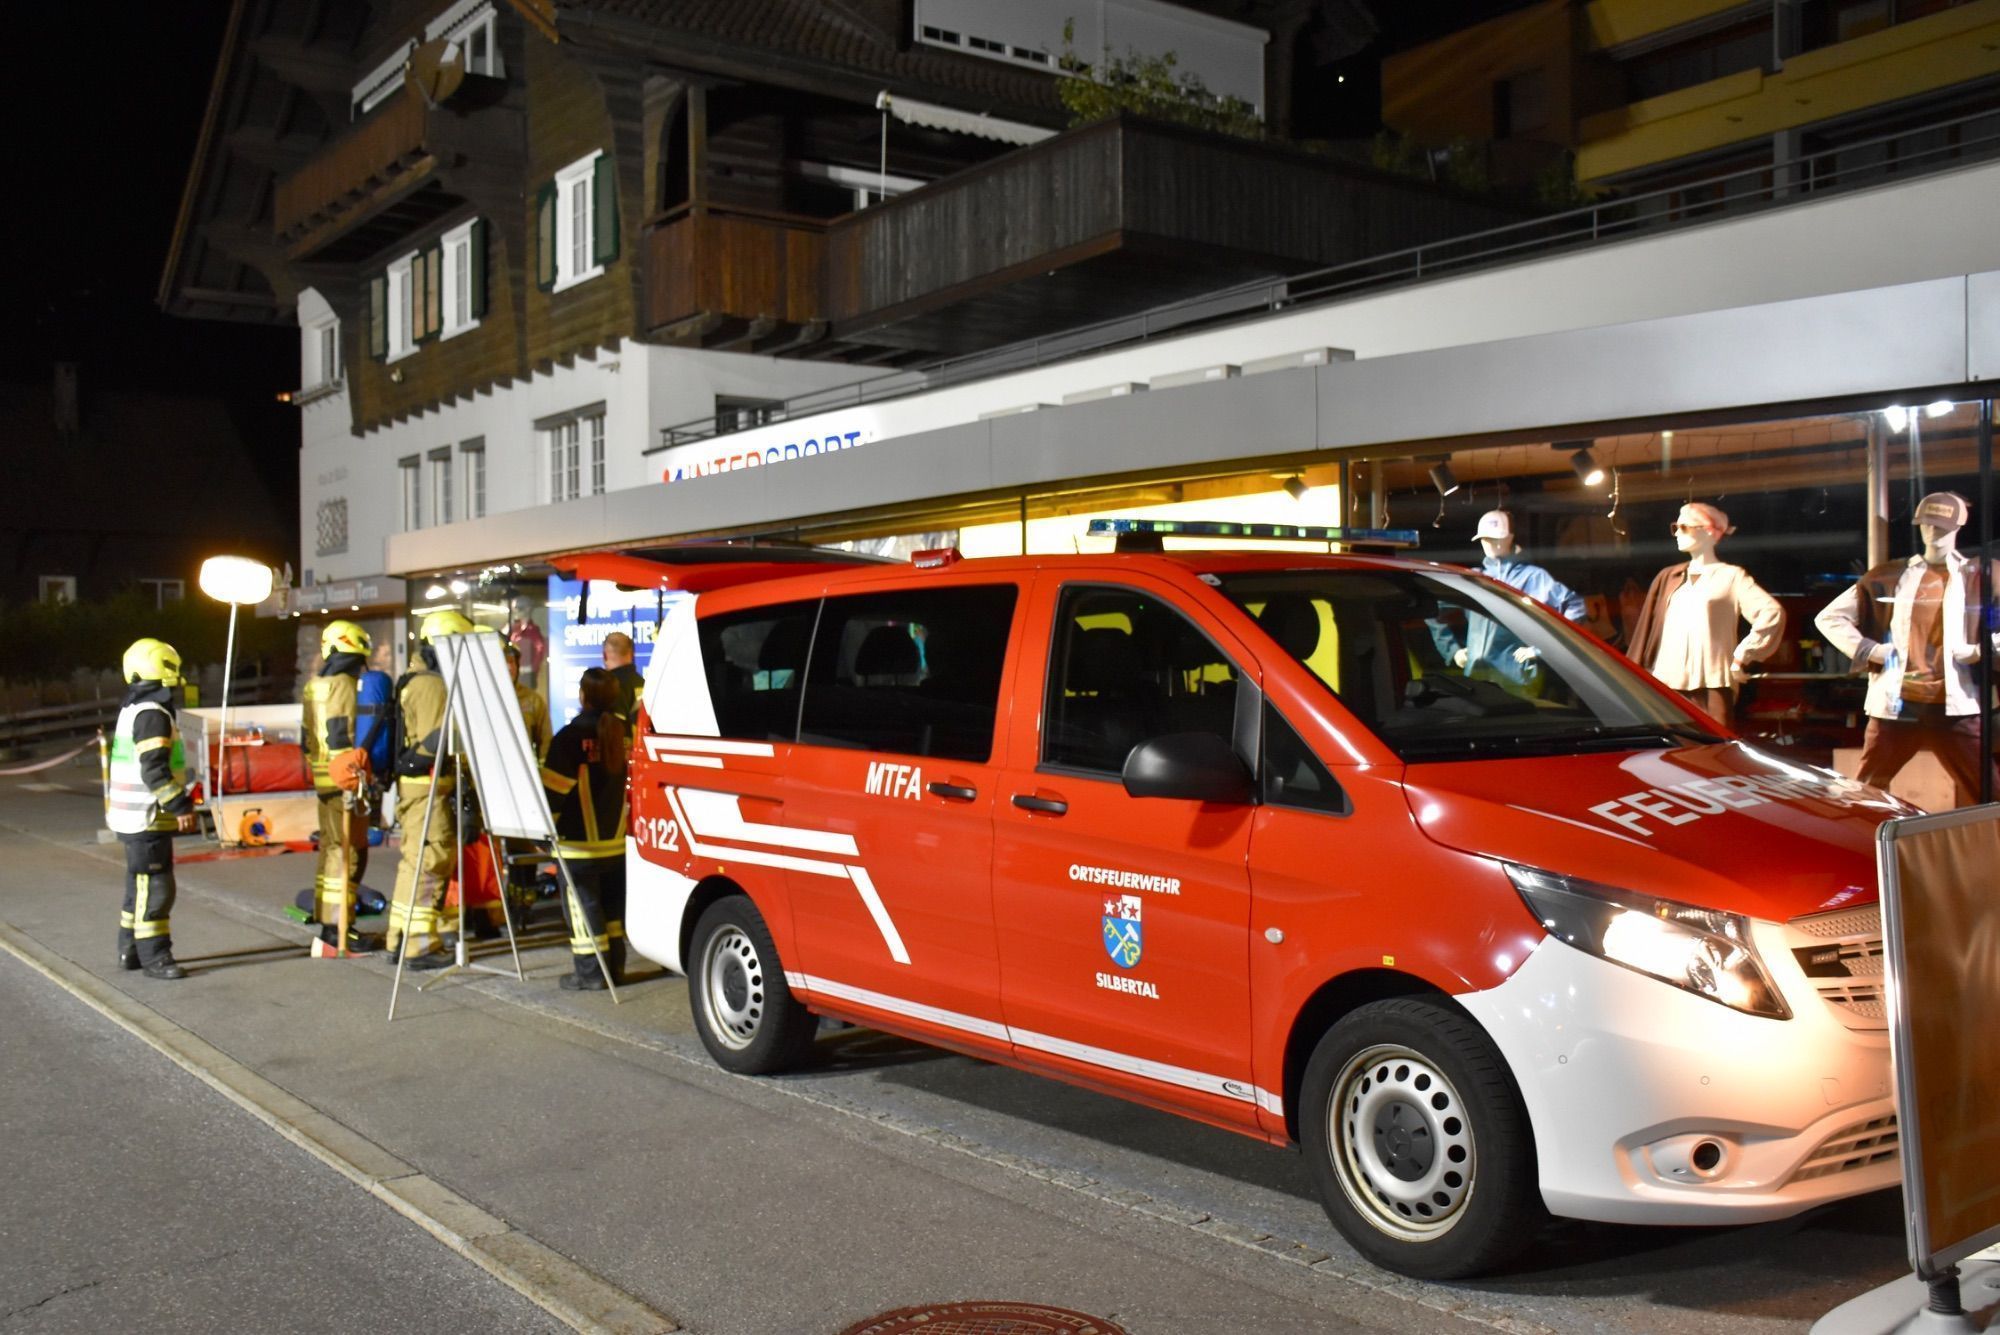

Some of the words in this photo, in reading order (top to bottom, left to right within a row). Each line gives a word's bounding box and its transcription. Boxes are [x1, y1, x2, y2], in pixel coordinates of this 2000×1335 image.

[864, 761, 921, 801] MTFA
[1587, 771, 1866, 837] FEUERWE
[648, 817, 680, 853] 122
[1068, 863, 1181, 896] ORTSFEUERWEHR
[1095, 971, 1160, 1000] SILBERTAL
